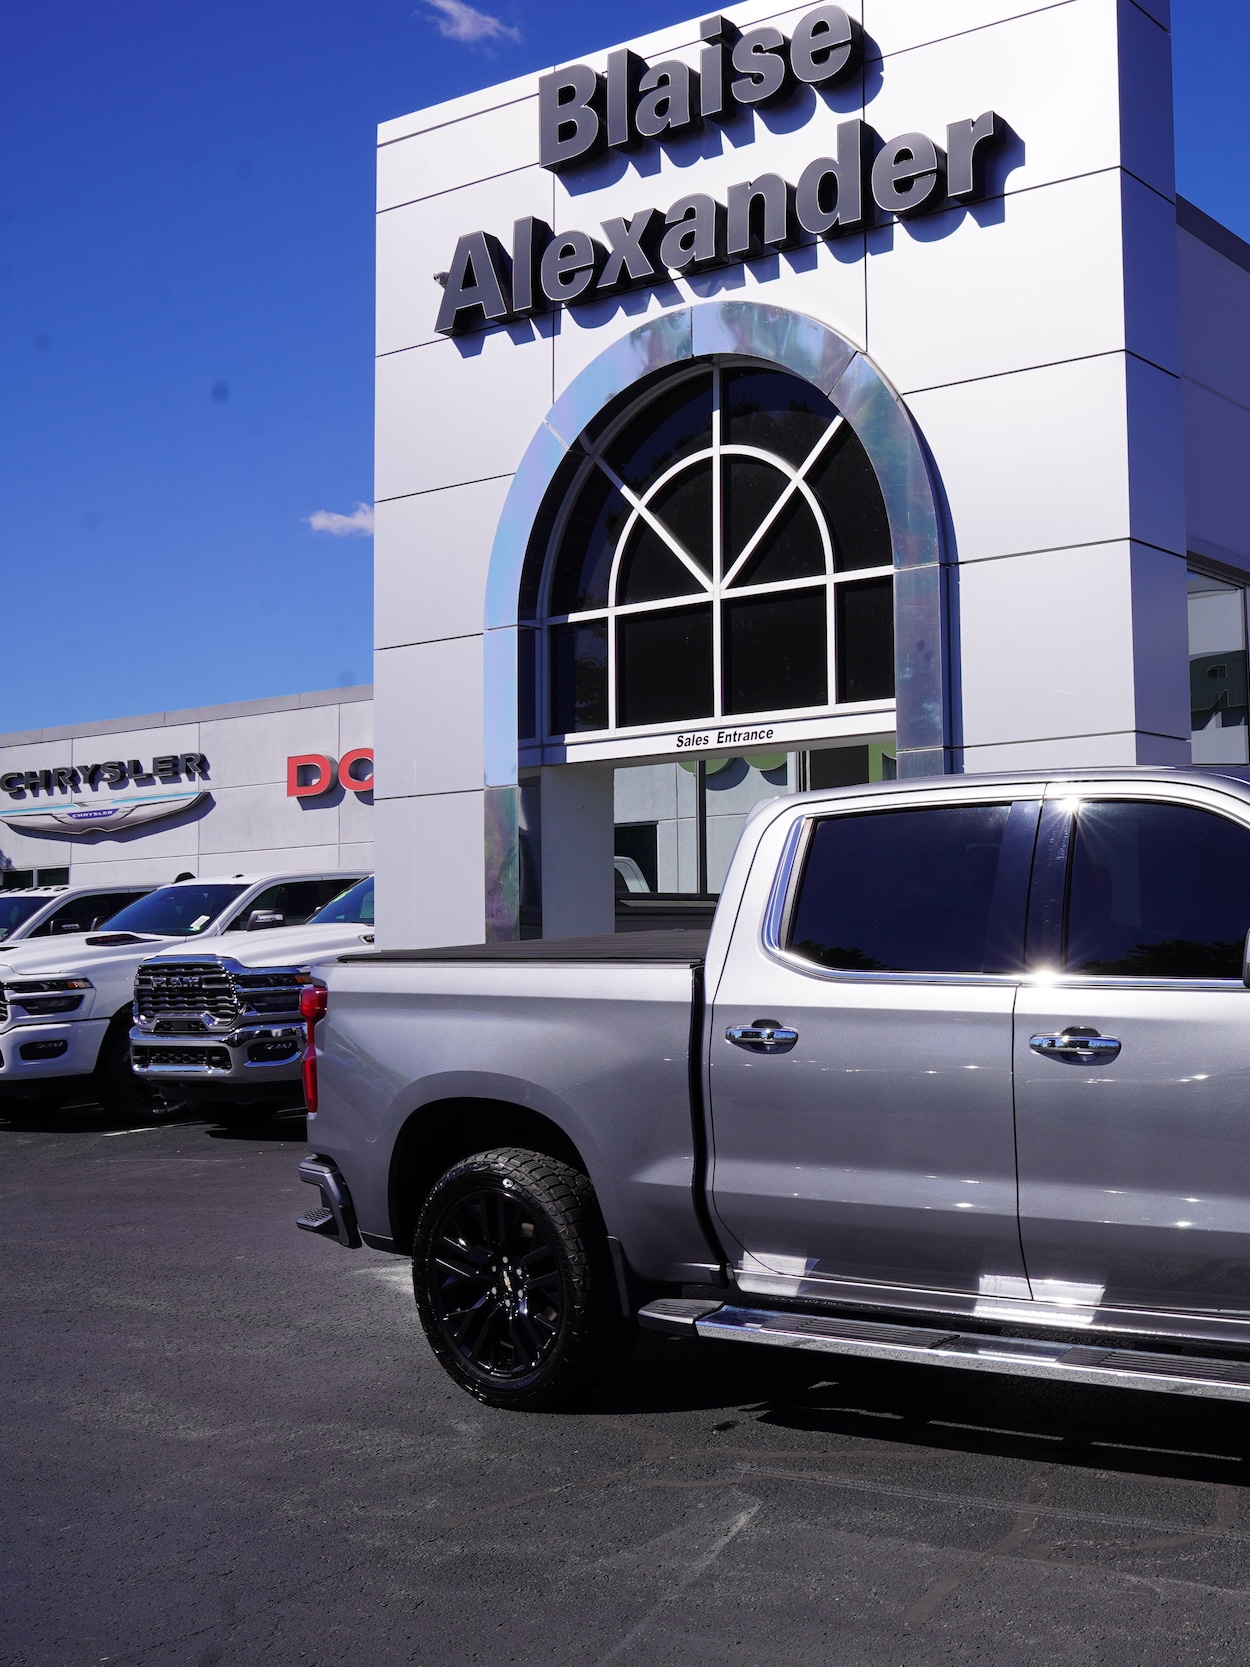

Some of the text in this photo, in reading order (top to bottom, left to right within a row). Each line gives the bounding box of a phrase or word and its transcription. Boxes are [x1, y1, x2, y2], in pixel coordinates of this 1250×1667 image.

[539, 4, 857, 171] Blaise
[434, 110, 998, 335] Alexander
[676, 729, 774, 748] Sales Entrance
[0, 753, 203, 793] CHRYSLER
[71, 810, 113, 818] CHRYSLER
